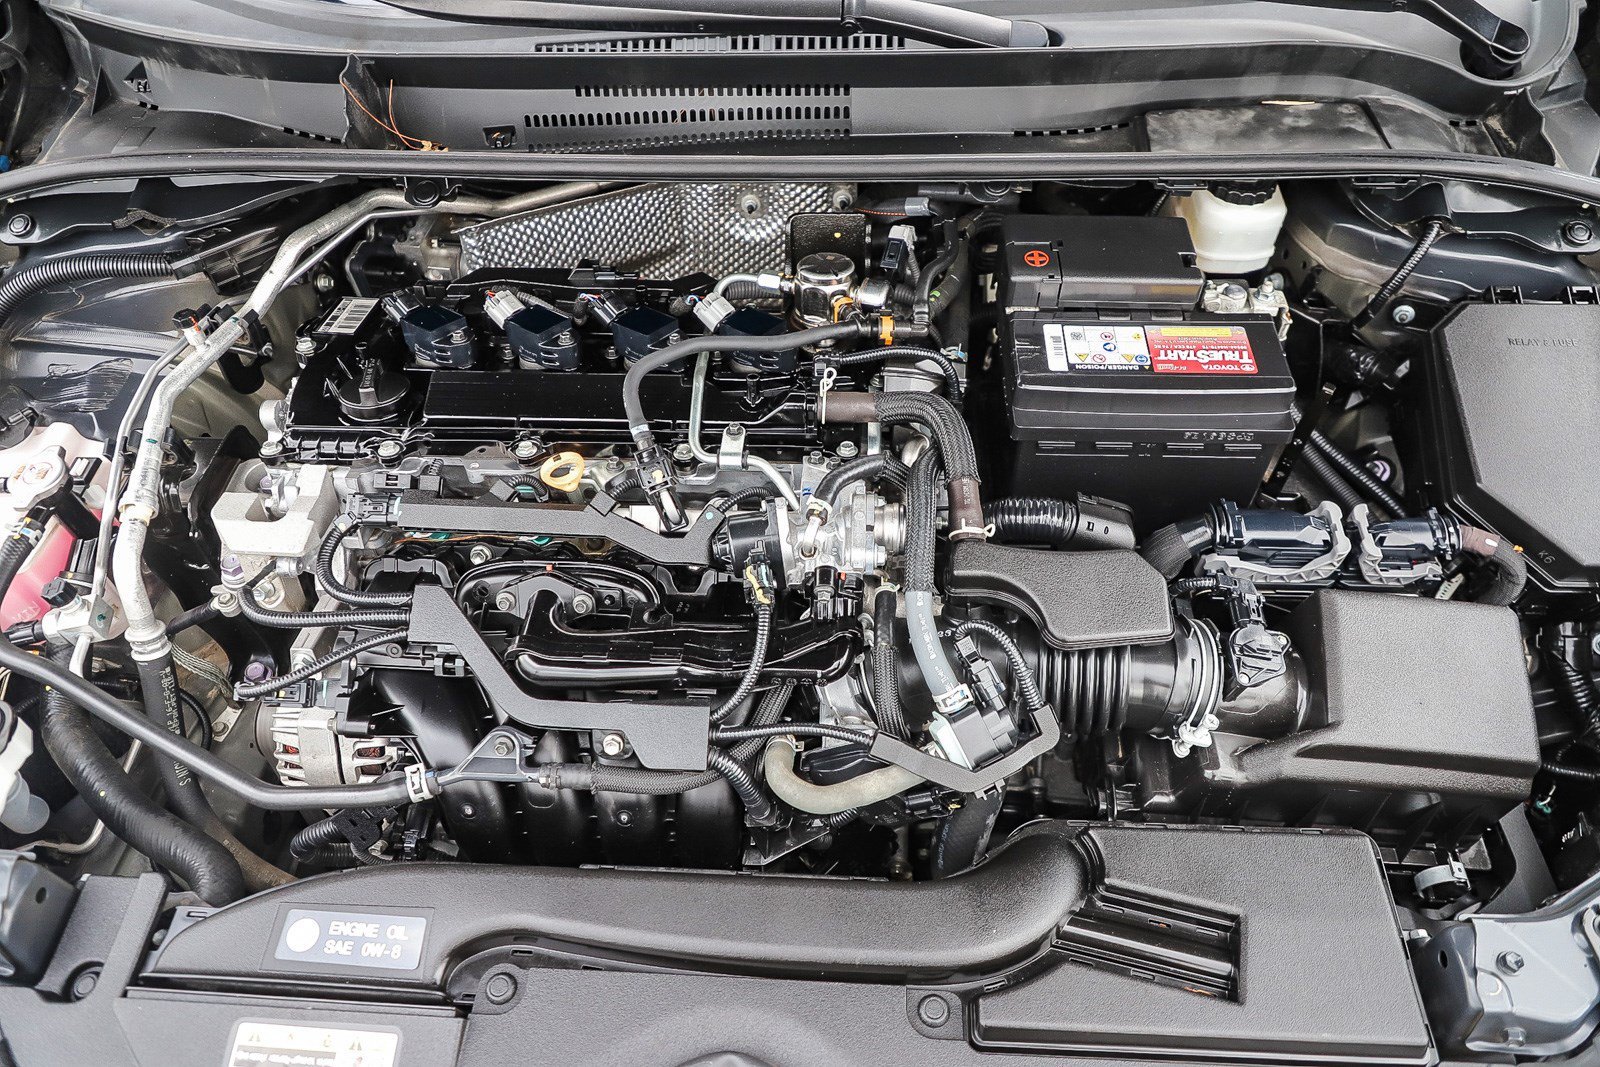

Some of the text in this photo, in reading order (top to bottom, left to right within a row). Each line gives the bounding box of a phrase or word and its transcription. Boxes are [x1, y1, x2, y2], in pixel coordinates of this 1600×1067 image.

[1507, 337, 1539, 347] RELAY
[328, 920, 409, 940] ENGINE OIL
[323, 939, 355, 955] SAE
